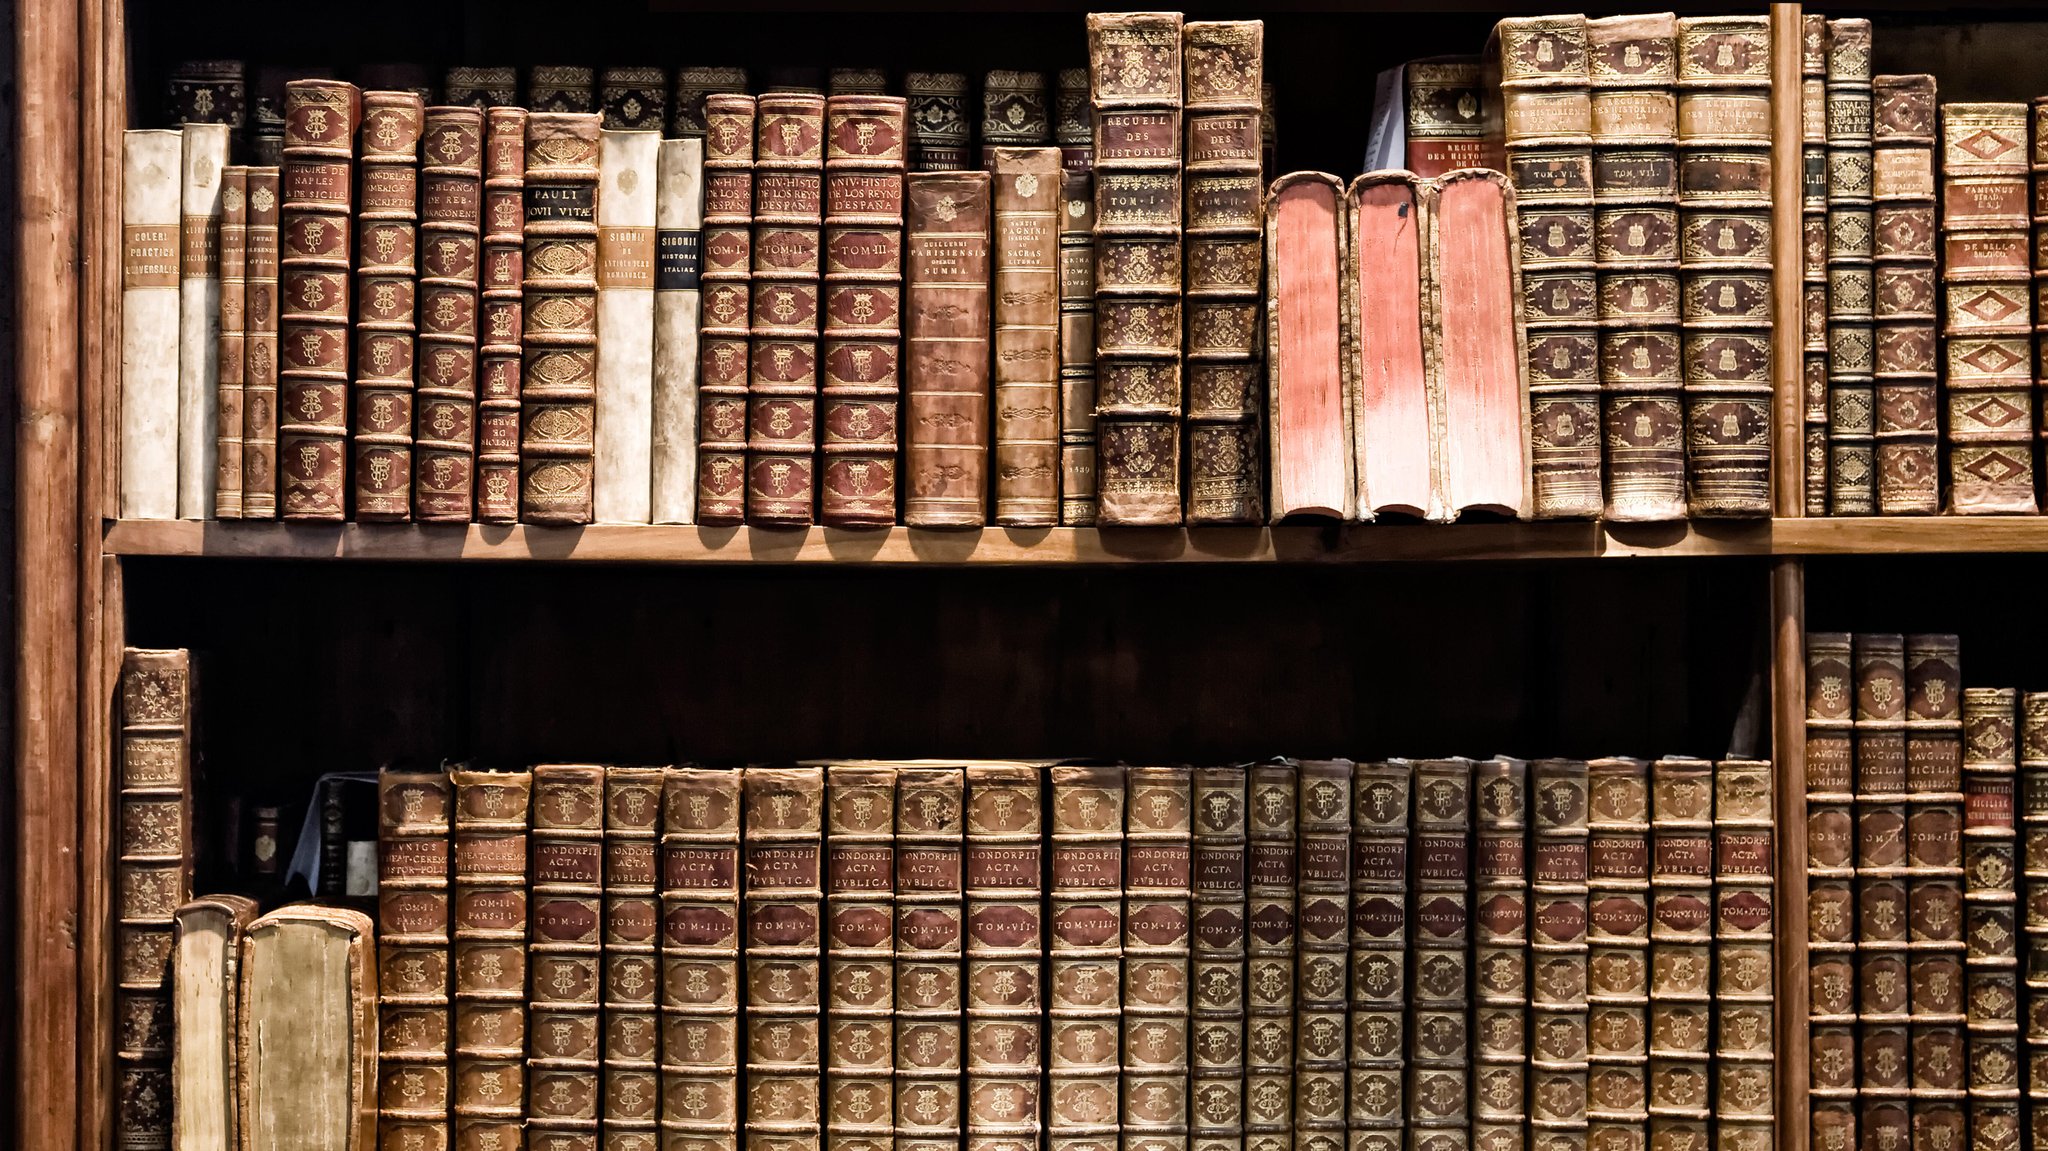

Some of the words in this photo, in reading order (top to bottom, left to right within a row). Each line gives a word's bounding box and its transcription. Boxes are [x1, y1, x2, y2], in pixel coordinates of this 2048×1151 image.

[1607, 98, 1650, 106] RECUEIL
[1706, 100, 1751, 108] RECUEIL
[1830, 101, 1870, 109] ANNALES
[1108, 116, 1166, 126] RECUEIL
[1198, 121, 1247, 131] RECUEIL
[1608, 123, 1651, 131] FRANCE
[1126, 133, 1149, 142] DES
[1210, 136, 1232, 145] DES
[1102, 147, 1173, 158] HISTORIEN
[1194, 149, 1254, 160] HISTORIEN
[1428, 153, 1445, 161] DES
[332, 167, 345, 176] DE
[295, 177, 334, 186] NAPLES
[310, 190, 345, 199] SICILE
[535, 190, 577, 200] PAULI
[720, 190, 740, 198] LOS
[773, 190, 792, 198] LOS
[845, 190, 864, 198] LOS
[428, 196, 440, 204] DE
[560, 207, 592, 217] VITÆ
[156, 758, 174, 766] LES
[1593, 839, 1644, 849] LONDORPII
[751, 850, 815, 859] LONDORPII
[972, 851, 1036, 860] LONDORPII
[1057, 852, 1118, 860] LONDORPII
[1310, 854, 1338, 863] ACTA
[1428, 853, 1456, 862] ACTA
[1488, 853, 1516, 862] ACTA
[1602, 852, 1634, 860] ACTA
[1668, 851, 1696, 860] ACTA
[1731, 851, 1758, 859] ACTA
[549, 858, 579, 866] ACTA
[616, 859, 648, 867] ACTA
[764, 861, 798, 870] ACTA
[1257, 860, 1286, 868] ACTA
[1364, 857, 1393, 866] ACTA
[1548, 857, 1578, 866] ACTA
[680, 862, 714, 872] ACTA
[846, 864, 876, 873] ACTA
[911, 865, 941, 873] ACTA
[986, 863, 1019, 872] ACTA
[1070, 864, 1101, 872] ACTA
[1144, 863, 1174, 872] ACTA
[1204, 865, 1231, 873] ACTA
[1479, 867, 1523, 875] PVBLICA
[1594, 865, 1644, 874] PVBLICA
[1657, 865, 1709, 874] PVBLICA
[1721, 864, 1768, 874] PVBLICA
[539, 871, 593, 880] PVBLICA
[610, 873, 656, 882] PVBLICA
[1303, 869, 1344, 878] PVBLICA
[1357, 869, 1403, 878] PVBLICA
[1420, 869, 1464, 877] PVBLICA
[1538, 871, 1585, 880] PVBLICA
[669, 878, 730, 887] PVBLICA
[753, 876, 812, 886] PVBLICA
[835, 878, 888, 887] PVBLICA
[900, 878, 954, 888] PVBLICA
[974, 876, 1034, 885] PVBLICA
[1058, 877, 1115, 886] PVBLICA
[1133, 876, 1186, 886] PVBLICA
[1252, 875, 1292, 884] PVBLICA
[1197, 881, 1242, 889] PVBLICA
